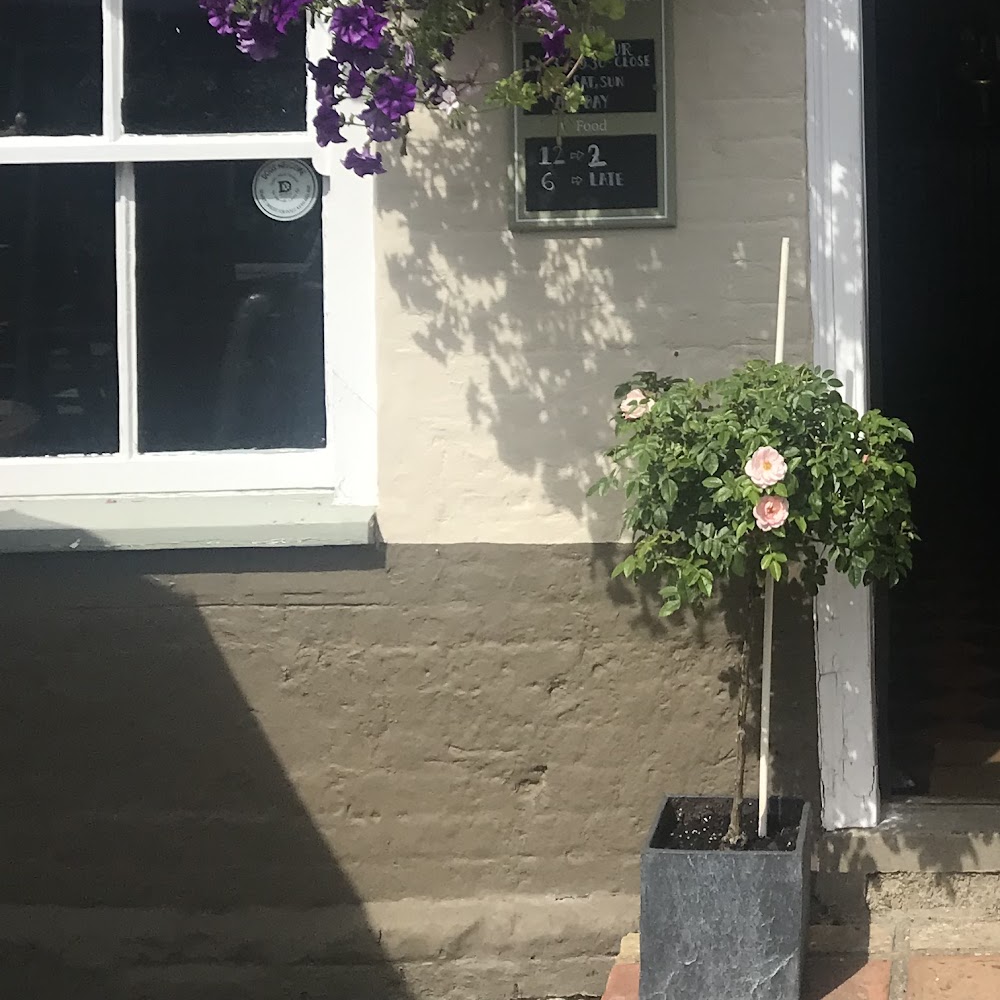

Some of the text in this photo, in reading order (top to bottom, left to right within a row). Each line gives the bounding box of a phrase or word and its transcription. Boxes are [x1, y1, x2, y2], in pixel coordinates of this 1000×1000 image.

[614, 55, 650, 68] CLOSE
[576, 119, 607, 132] Food
[539, 144, 607, 168] 12 2
[541, 171, 624, 191] 6 LATE
